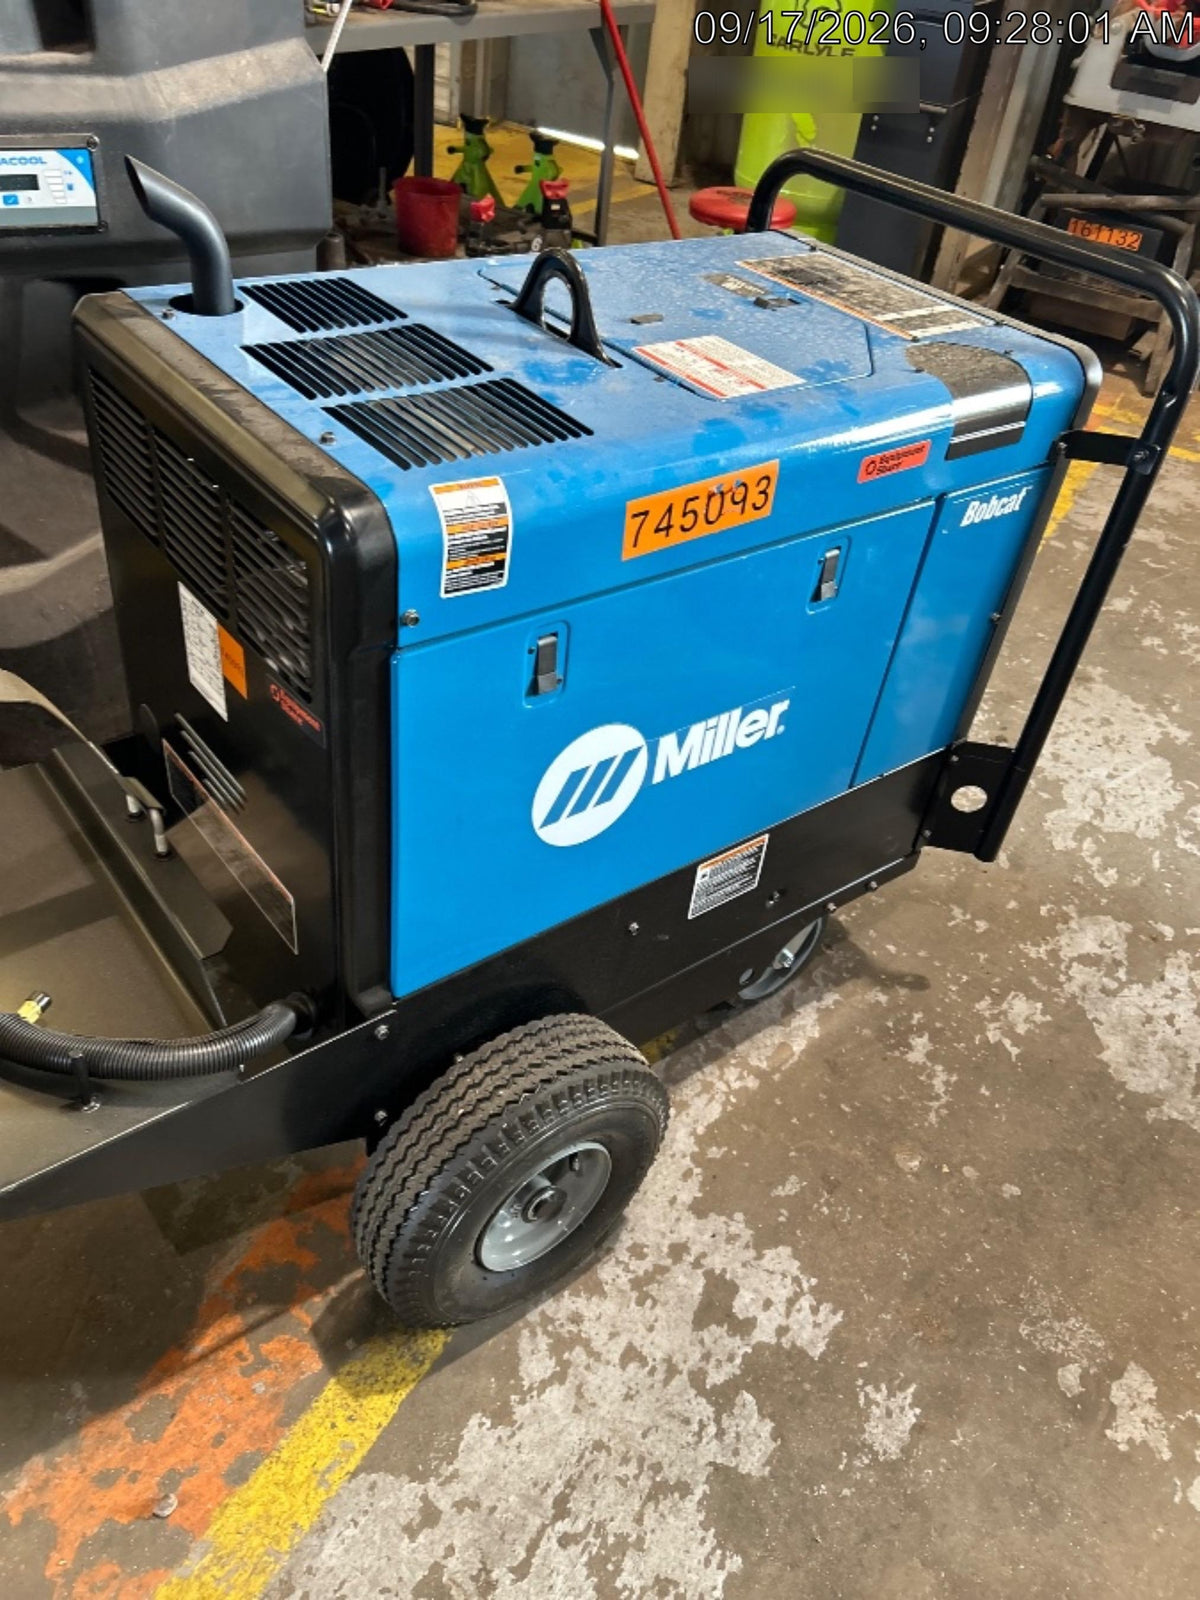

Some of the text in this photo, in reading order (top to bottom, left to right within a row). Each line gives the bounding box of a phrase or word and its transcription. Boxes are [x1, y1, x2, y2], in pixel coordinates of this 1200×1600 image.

[1070, 220, 1140, 250] 161132
[631, 475, 771, 548] 745093
[960, 487, 1029, 527] Bobcat
[652, 699, 790, 784] Miller
